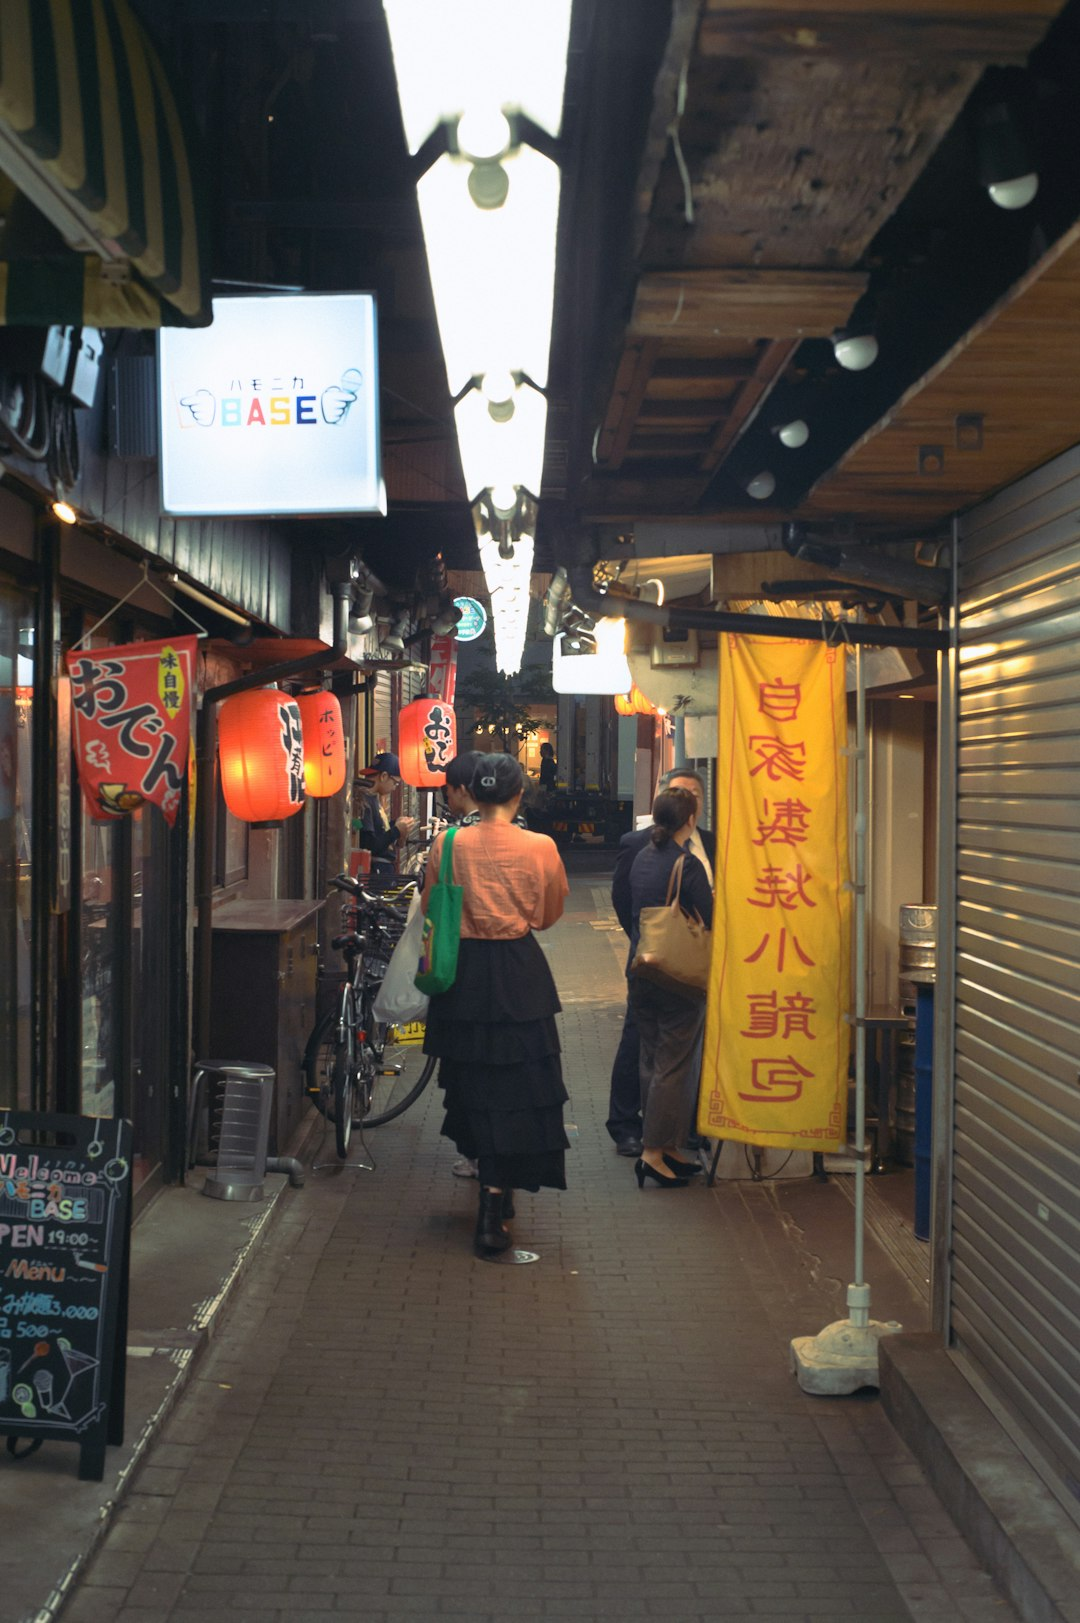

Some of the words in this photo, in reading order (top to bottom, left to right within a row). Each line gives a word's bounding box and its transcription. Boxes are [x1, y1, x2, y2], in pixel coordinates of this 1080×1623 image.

[230, 376, 304, 391] ハモニカ
[221, 396, 317, 427] BASE
[160, 653, 180, 708] 味自慢
[72, 659, 182, 793] おでん
[319, 709, 336, 776] ホッピー
[424, 706, 453, 773] おでん
[30, 1199, 87, 1220] BASE
[4, 1259, 66, 1282] Menu
